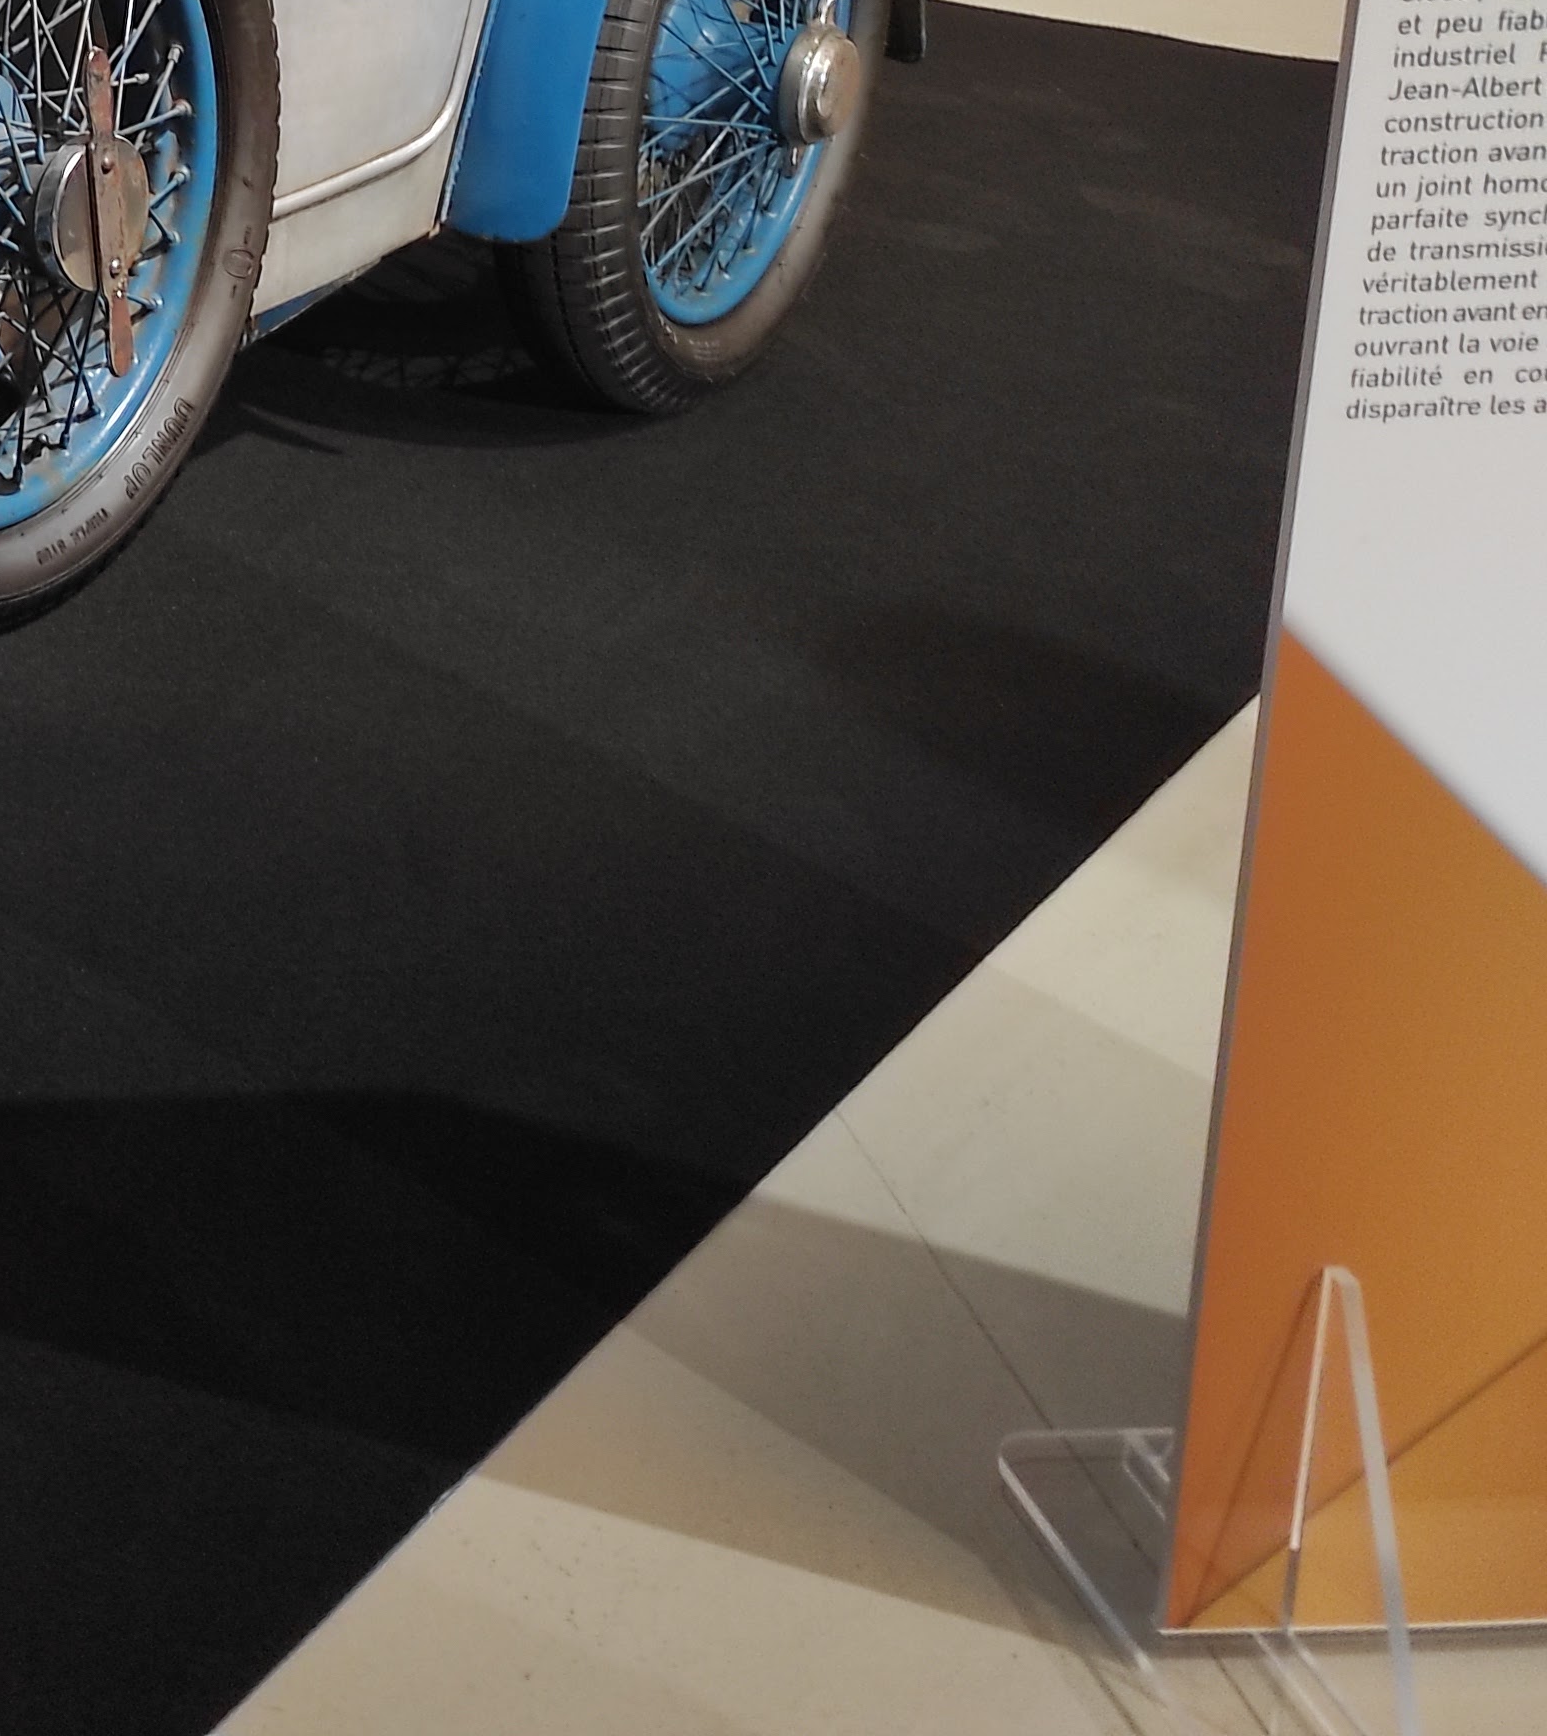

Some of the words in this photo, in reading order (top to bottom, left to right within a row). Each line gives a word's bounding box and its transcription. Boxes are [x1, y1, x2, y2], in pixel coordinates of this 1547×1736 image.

[1397, 14, 1421, 35] et
[1436, 16, 1483, 40] peu
[1498, 8, 1547, 32] fiab
[1393, 43, 1516, 68] industriel
[1388, 76, 1542, 102] Jean-Albert
[1384, 108, 1544, 134] construction
[1381, 142, 1478, 166] traction
[1488, 143, 1547, 164] avan
[1376, 179, 1407, 199] un
[1416, 174, 1473, 202] joint
[1371, 208, 1469, 235] parfaite
[1367, 241, 1396, 263] de
[1362, 268, 1538, 294] véritablement
[1359, 304, 1448, 326] traction
[1452, 302, 1516, 322] avant
[1522, 303, 1547, 321] en
[1354, 335, 1449, 358] ouvrant
[1459, 333, 1480, 354] la
[1490, 331, 1539, 353] voie
[1350, 365, 1443, 388] fiabilité
[1464, 366, 1493, 385] en
[1346, 394, 1481, 423] disparaître
[1490, 395, 1525, 415] les
[123, 397, 194, 499] DUNLOP
